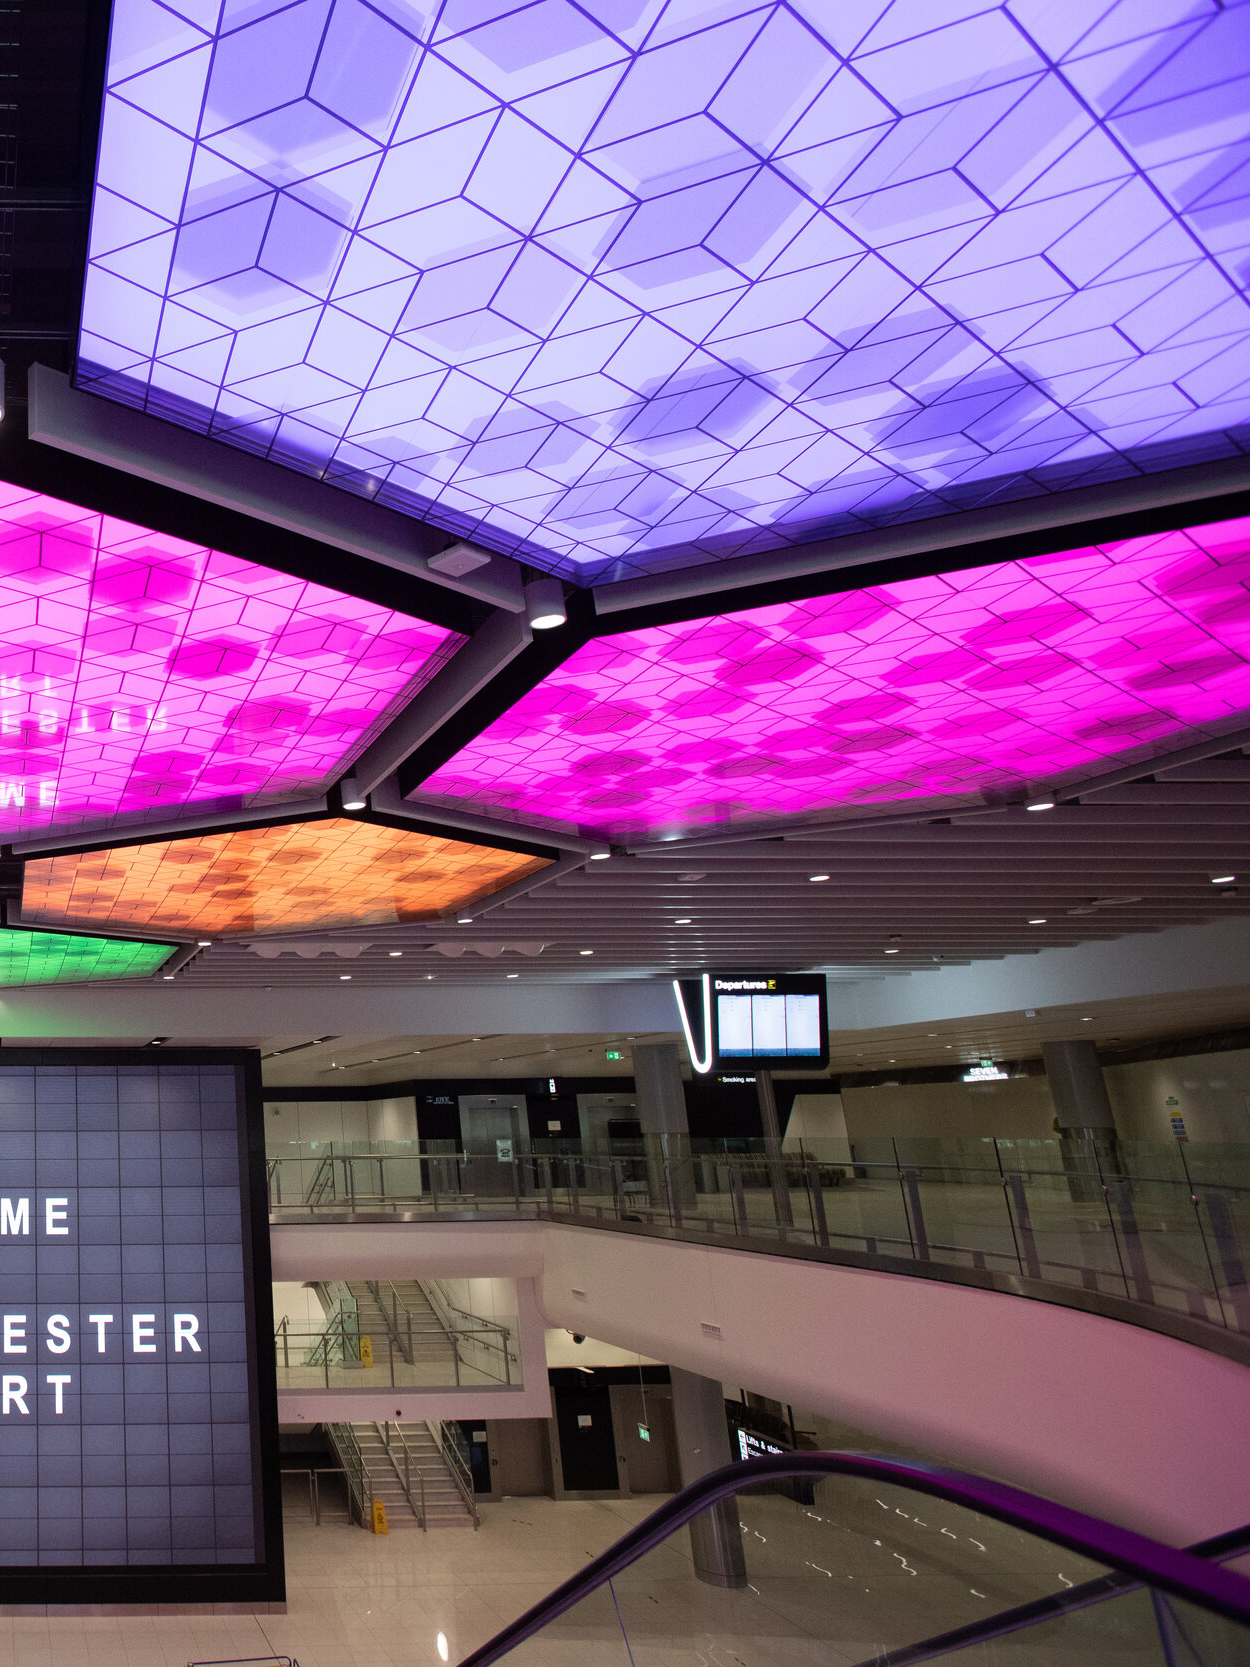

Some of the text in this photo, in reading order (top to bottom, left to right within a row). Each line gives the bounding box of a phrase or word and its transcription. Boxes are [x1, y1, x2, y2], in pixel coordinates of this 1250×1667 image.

[714, 979, 768, 991] Departures
[969, 1066, 999, 1076] SEVEN
[722, 1076, 745, 1084] Smoking
[746, 1434, 759, 1447] Lifts
[760, 1440, 766, 1450] &
